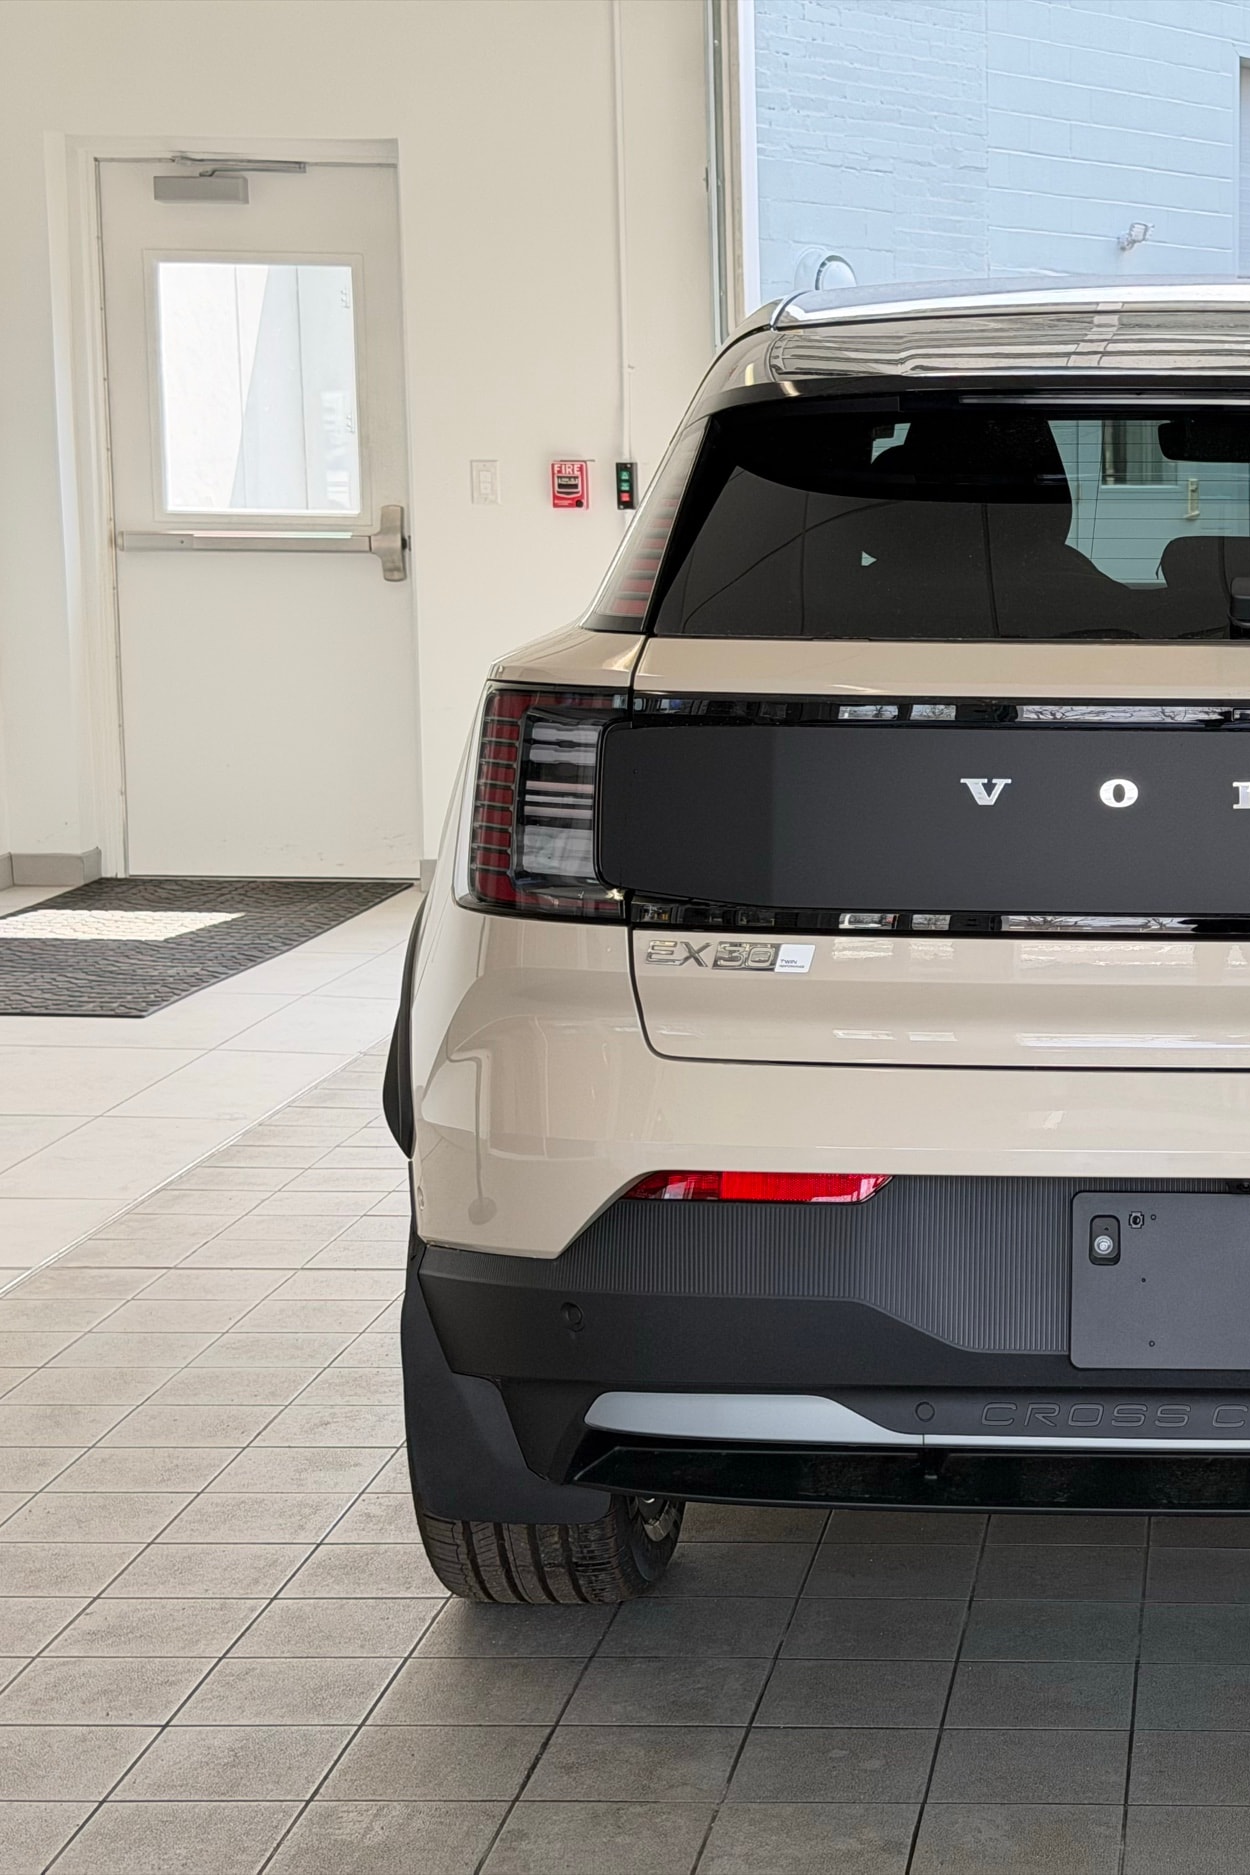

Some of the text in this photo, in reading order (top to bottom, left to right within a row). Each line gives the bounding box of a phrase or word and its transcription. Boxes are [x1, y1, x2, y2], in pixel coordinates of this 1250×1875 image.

[554, 464, 581, 475] FIRE
[645, 940, 777, 967] EX30
[981, 1402, 1191, 1429] CROSS
